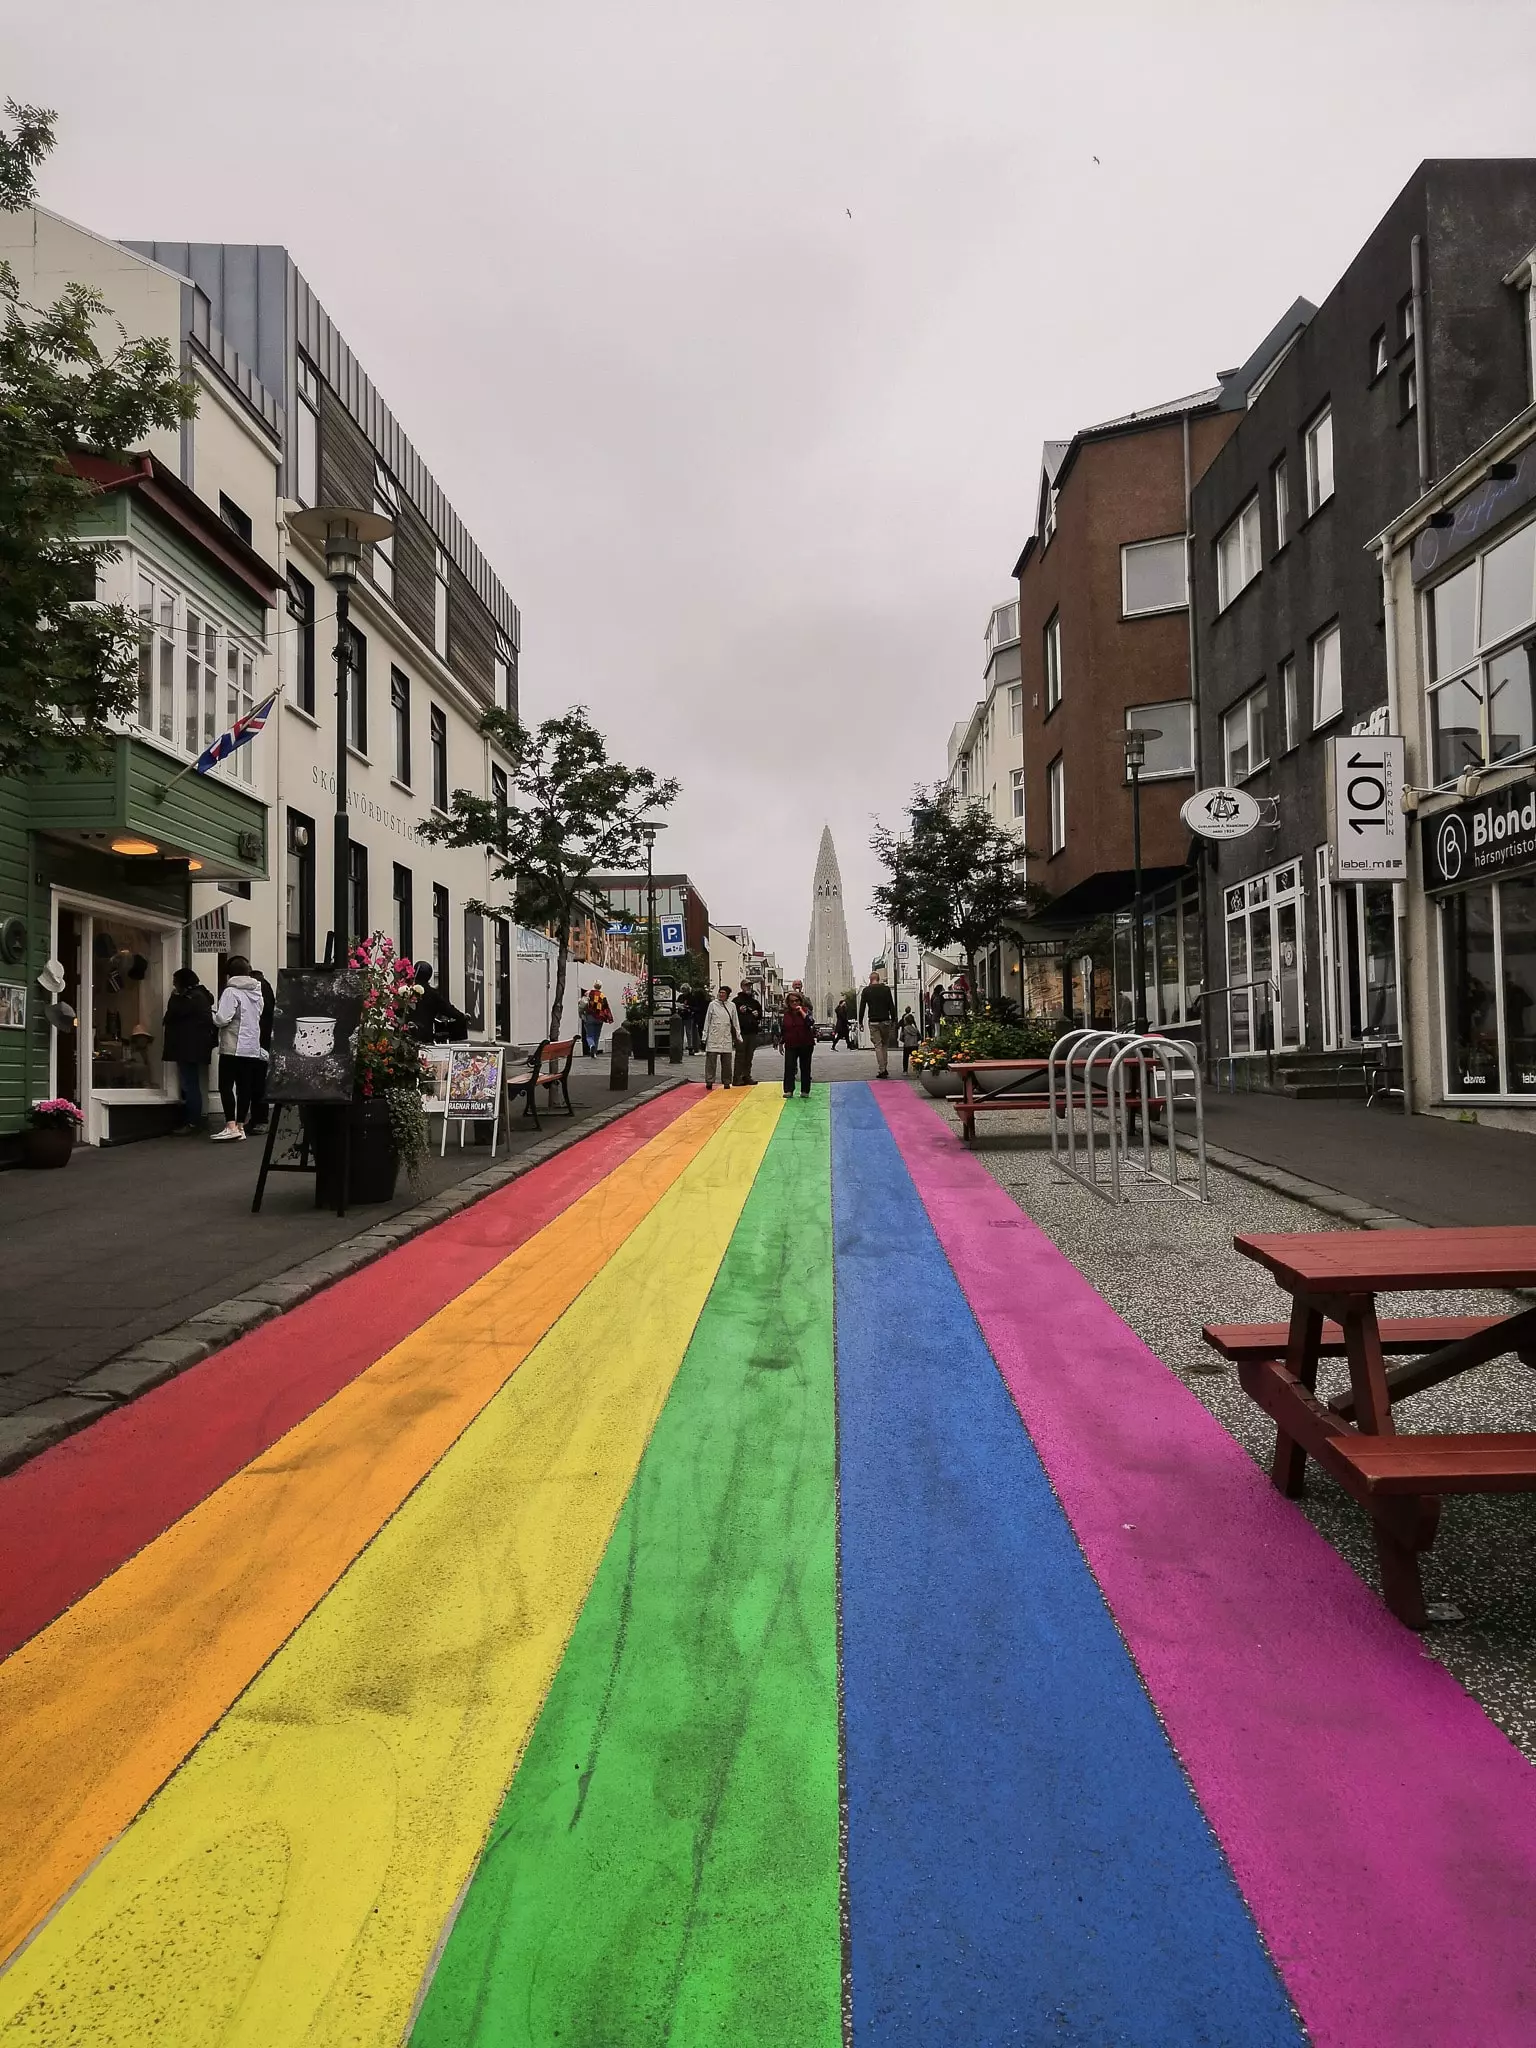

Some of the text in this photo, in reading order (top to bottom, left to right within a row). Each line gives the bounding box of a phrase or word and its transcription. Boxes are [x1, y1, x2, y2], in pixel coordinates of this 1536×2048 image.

[1347, 752, 1385, 835] 101
[1474, 834, 1536, 867] hársnyrtisto
[196, 931, 226, 940] TAX FREE
[667, 927, 678, 940] P
[197, 940, 227, 948] SHOPPING
